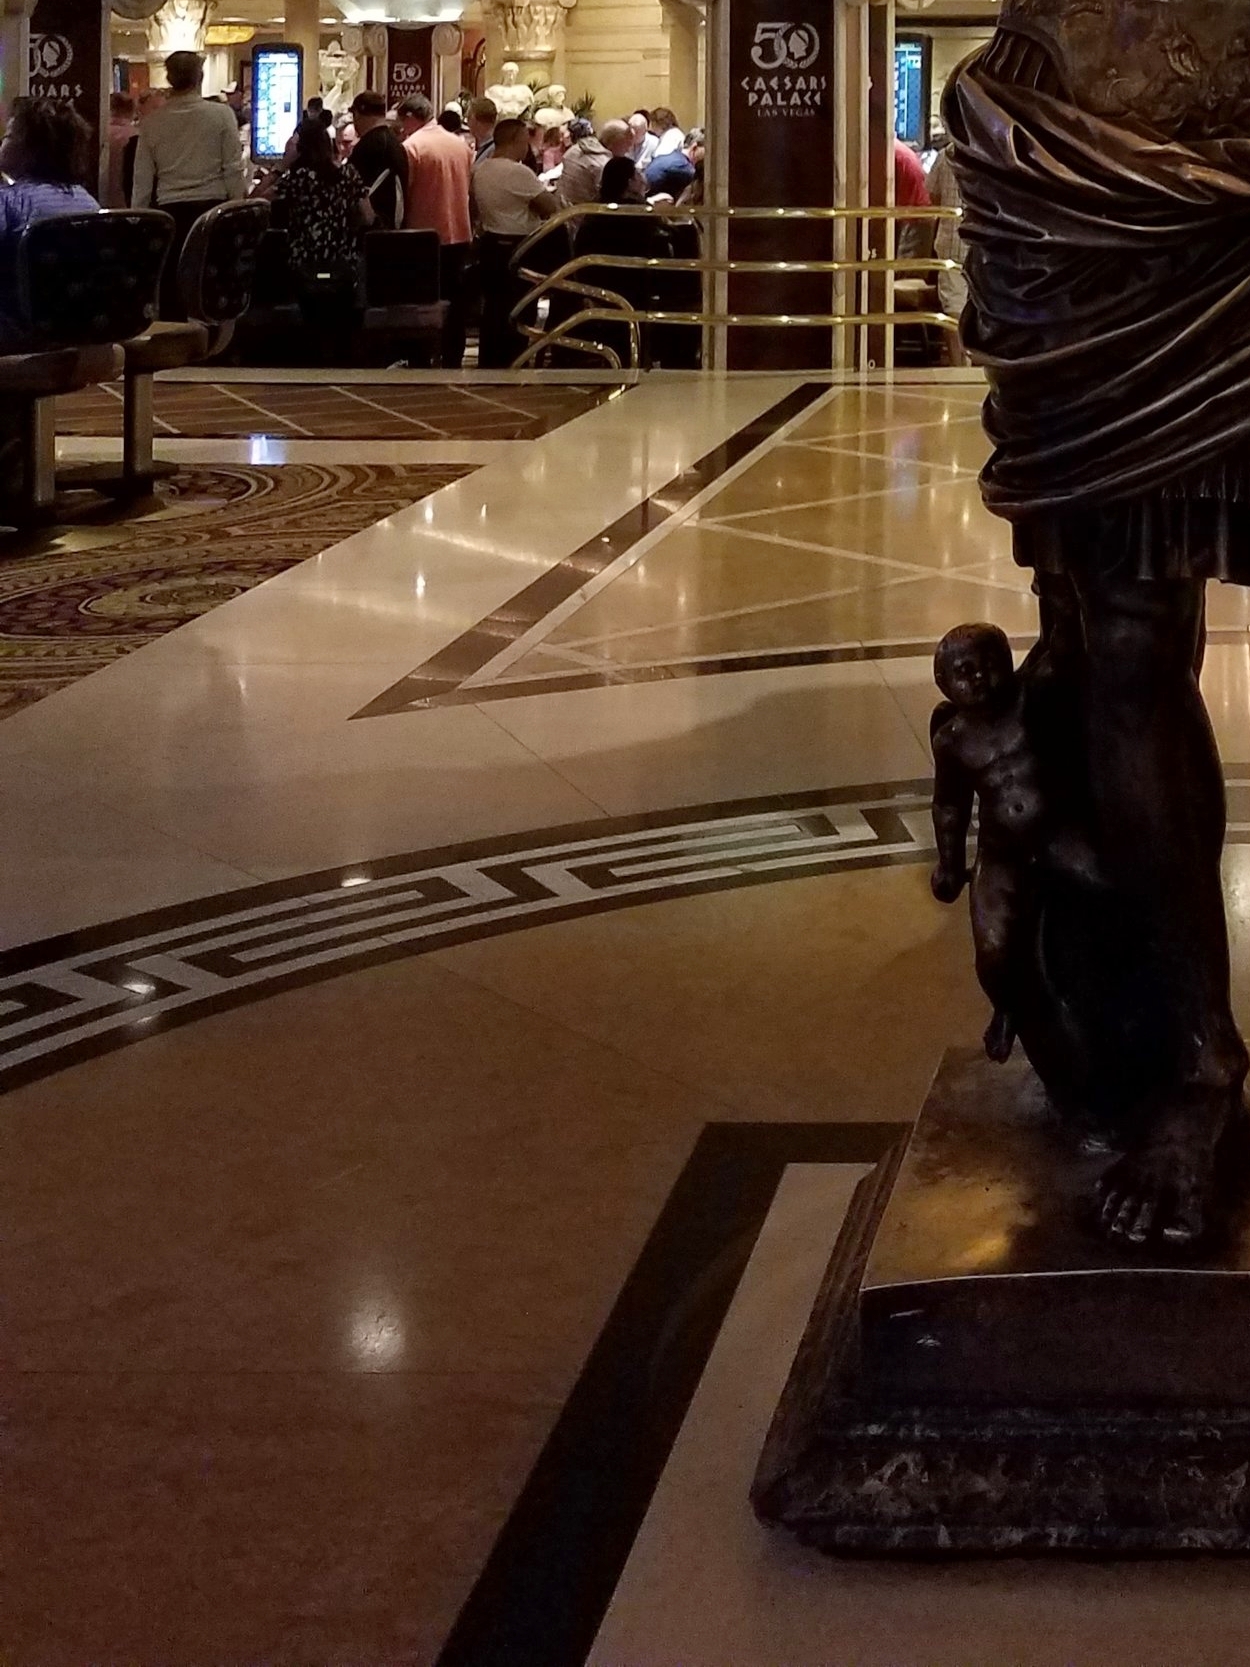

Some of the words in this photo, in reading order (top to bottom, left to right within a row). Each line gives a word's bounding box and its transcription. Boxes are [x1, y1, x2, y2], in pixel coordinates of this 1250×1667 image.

[750, 22, 820, 70] 50
[393, 62, 422, 83] 50
[741, 76, 827, 91] CAESARS
[748, 91, 822, 107] PALACE
